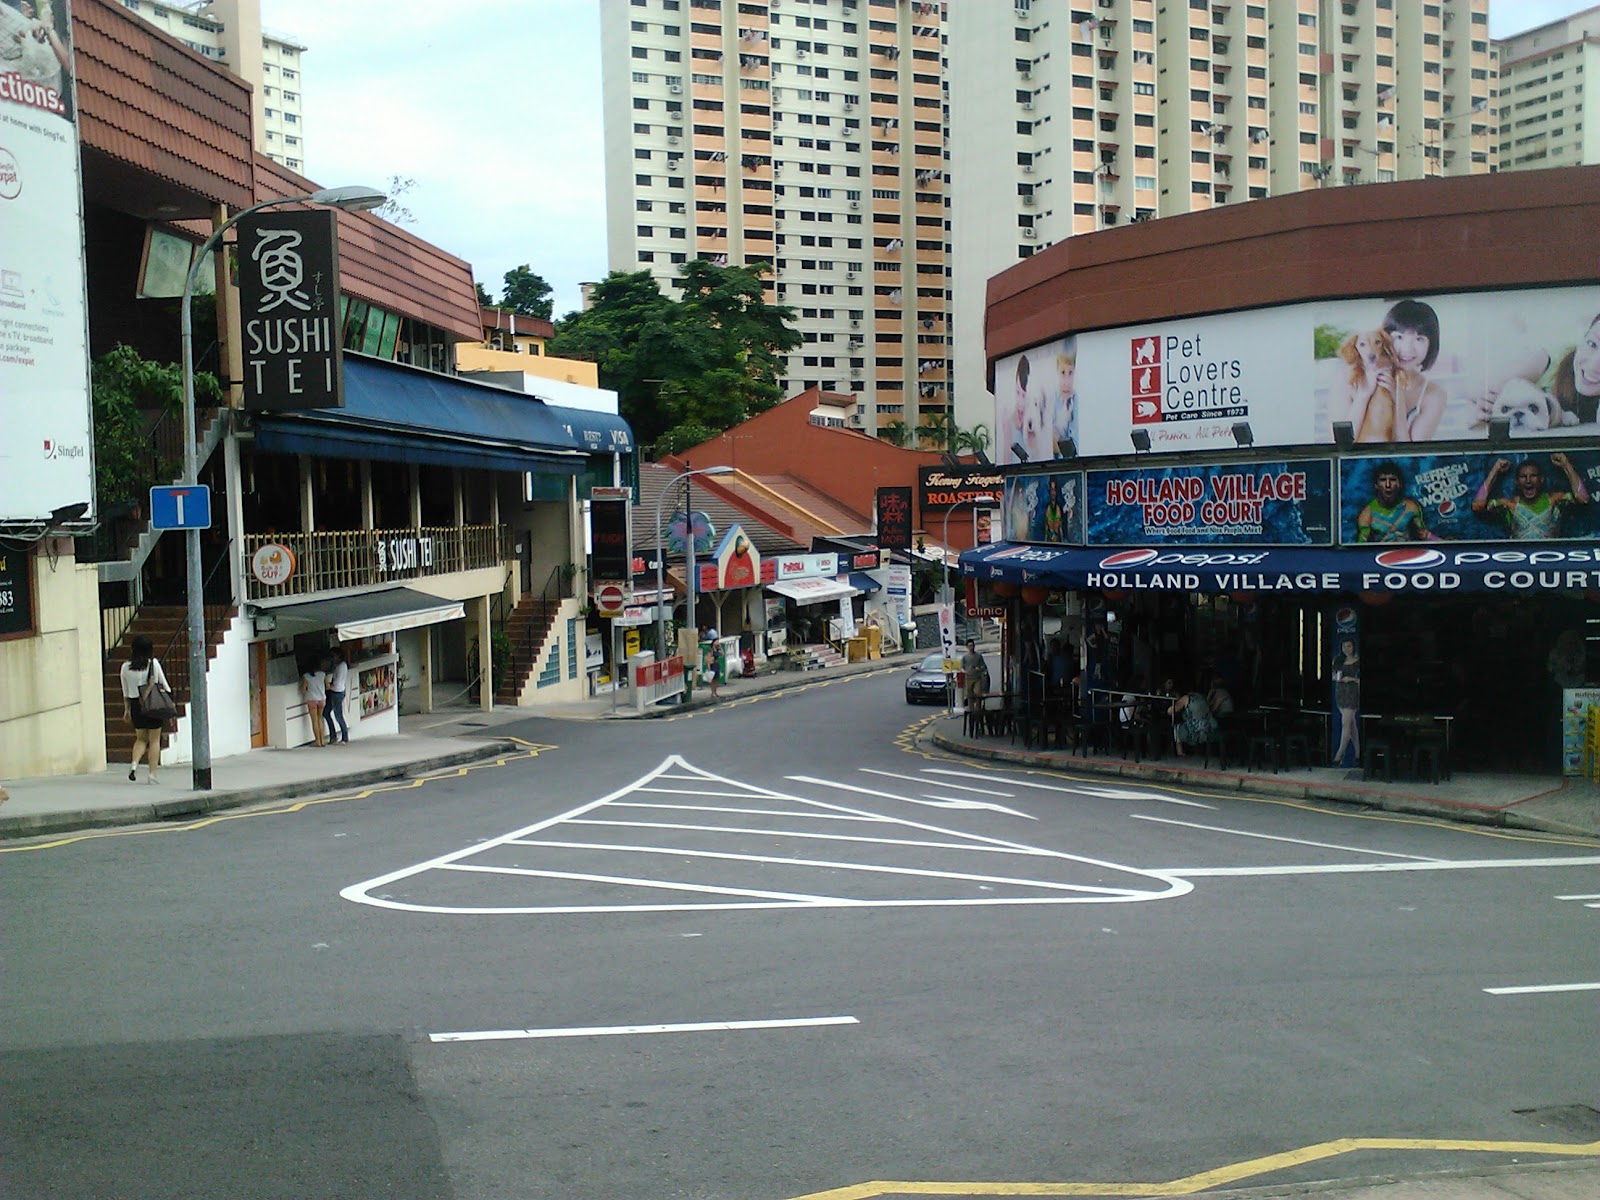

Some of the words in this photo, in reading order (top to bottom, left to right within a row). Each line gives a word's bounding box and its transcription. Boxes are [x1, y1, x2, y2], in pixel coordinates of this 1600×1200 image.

[246, 317, 331, 355] SUSHI
[1166, 333, 1202, 360] Pet
[250, 357, 332, 395] TEI
[1166, 358, 1242, 386] Lovers
[1166, 383, 1242, 411] Centre
[1165, 413, 1178, 422] Pet
[1180, 411, 1199, 420] Care
[1201, 410, 1223, 419] Since
[608, 429, 630, 446] VISA
[57, 445, 84, 459] SingTel
[1415, 462, 1469, 486] REFRESH
[1424, 474, 1460, 493] YOUR
[1106, 477, 1204, 506] HOLLAND
[1211, 471, 1307, 502] VILLAGE
[1418, 483, 1469, 508] WORLD
[1143, 501, 1196, 527] FOOD
[1202, 500, 1264, 525] COURT
[390, 537, 417, 572] SUSHI
[419, 537, 433, 567] TEI
[1148, 551, 1269, 567] pepsi
[1087, 573, 1200, 590] HOLLAND
[1215, 572, 1341, 590] VILLAGE
[1362, 572, 1461, 590] FOOD
